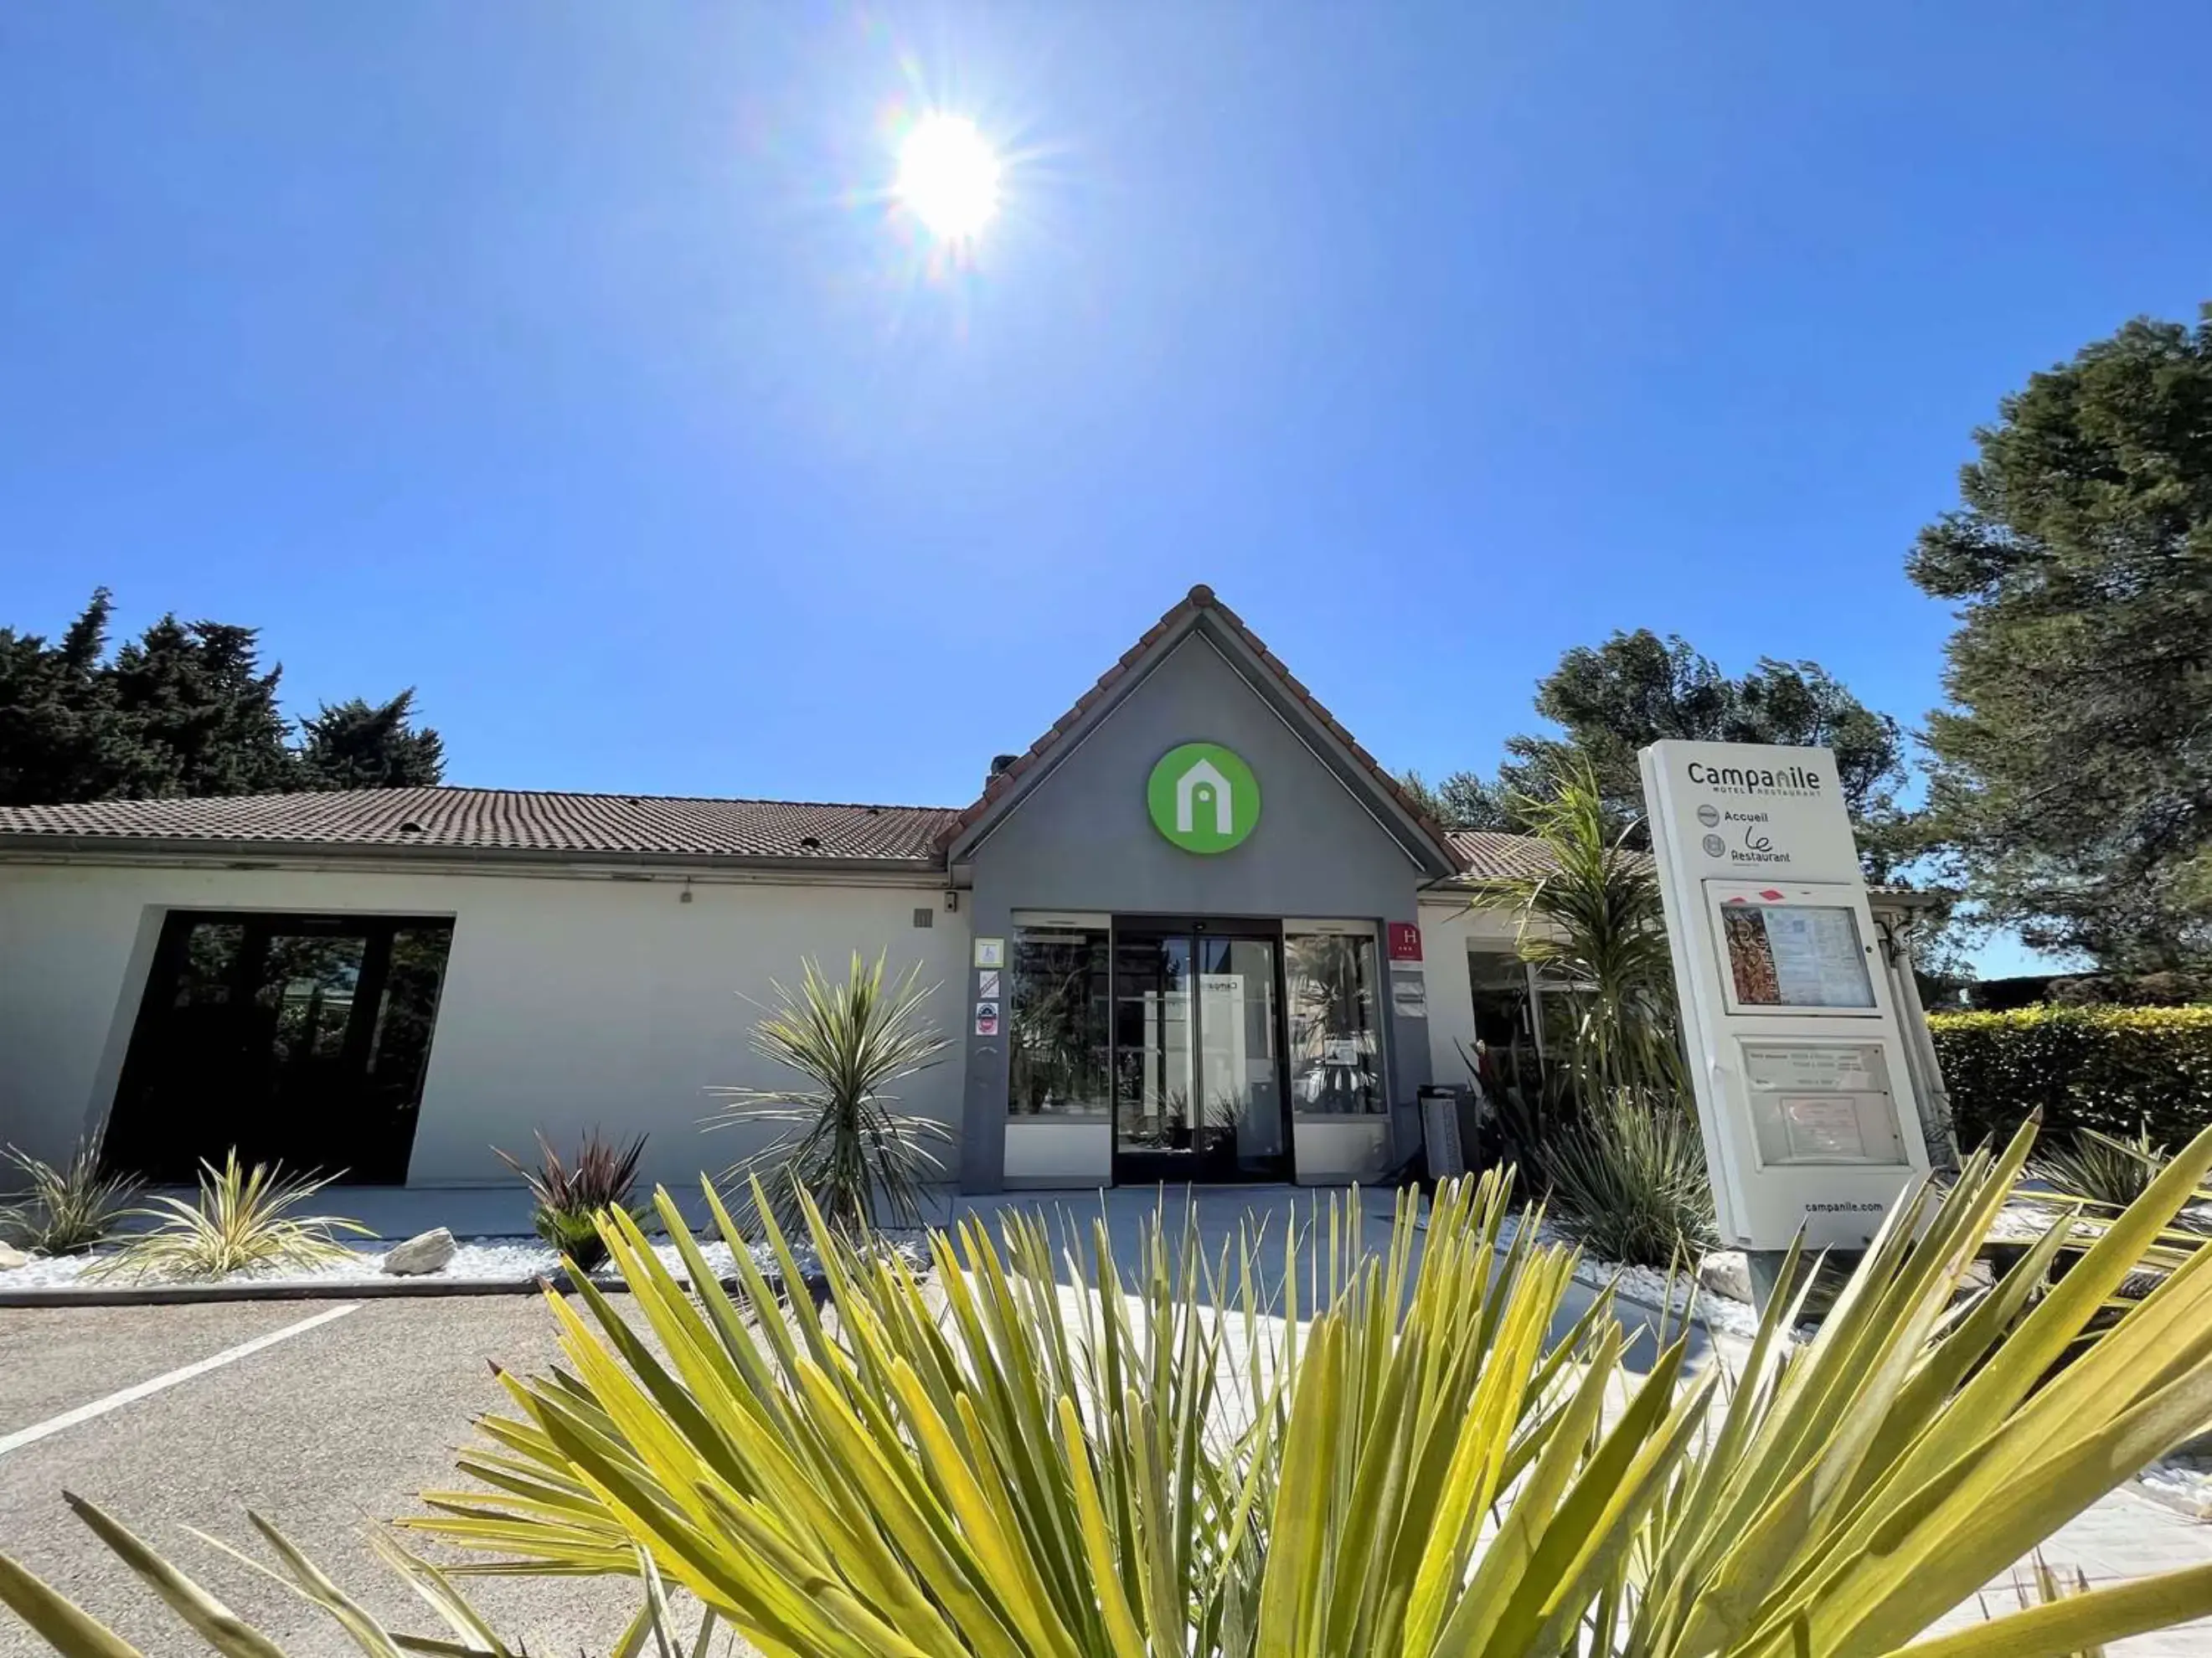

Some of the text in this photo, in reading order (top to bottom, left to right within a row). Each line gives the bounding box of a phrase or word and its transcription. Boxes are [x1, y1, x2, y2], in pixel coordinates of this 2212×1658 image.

[1688, 762, 1821, 794] Campanile
[1758, 788, 1821, 796] RESTAURANT
[1725, 811, 1769, 822] Accueil
[1745, 826, 1772, 852] Le
[1730, 850, 1791, 862] Restaurant
[1404, 929, 1416, 943] H
[1805, 1202, 1884, 1213] campanile.com
